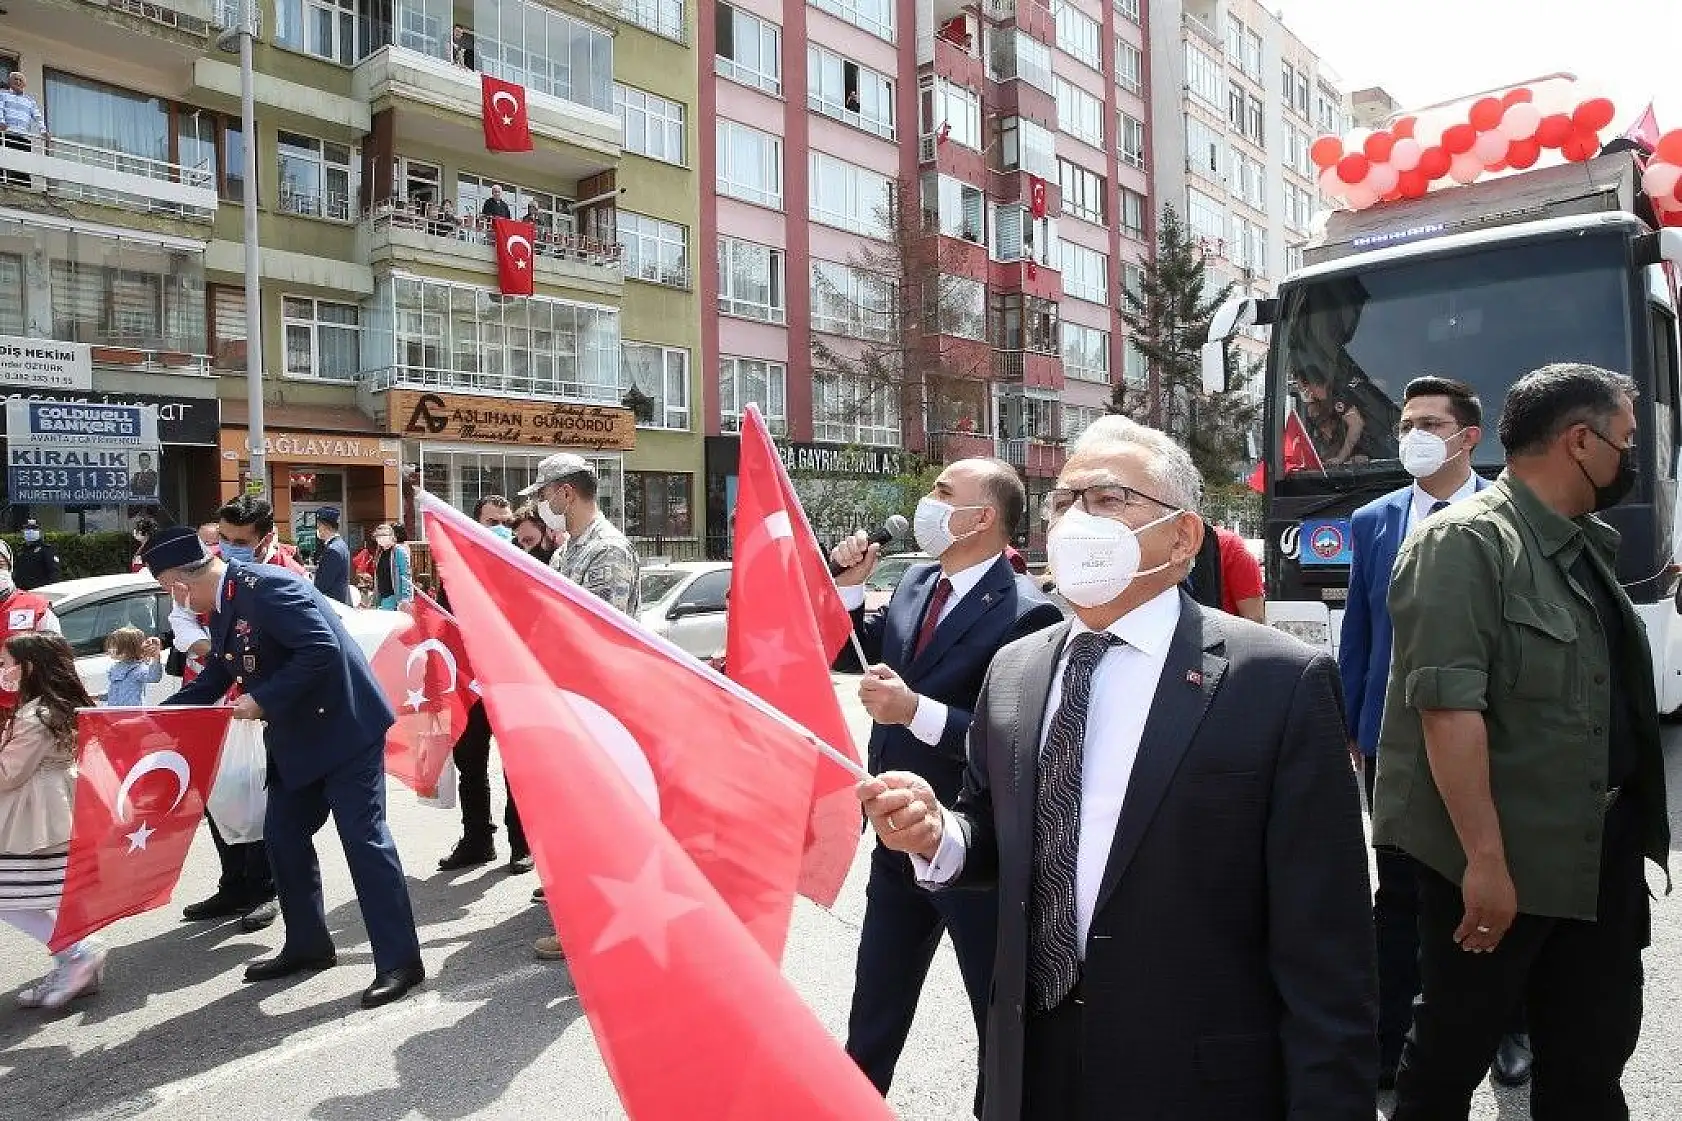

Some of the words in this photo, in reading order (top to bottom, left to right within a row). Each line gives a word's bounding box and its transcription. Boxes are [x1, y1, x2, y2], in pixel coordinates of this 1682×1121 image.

[25, 347, 76, 362] HEKİMİ
[38, 406, 133, 422] COLDWELL
[40, 418, 116, 433] BANKER
[12, 447, 126, 466] KİRALIK
[32, 470, 68, 486] 333
[76, 470, 98, 487] 11
[105, 471, 127, 487] 33
